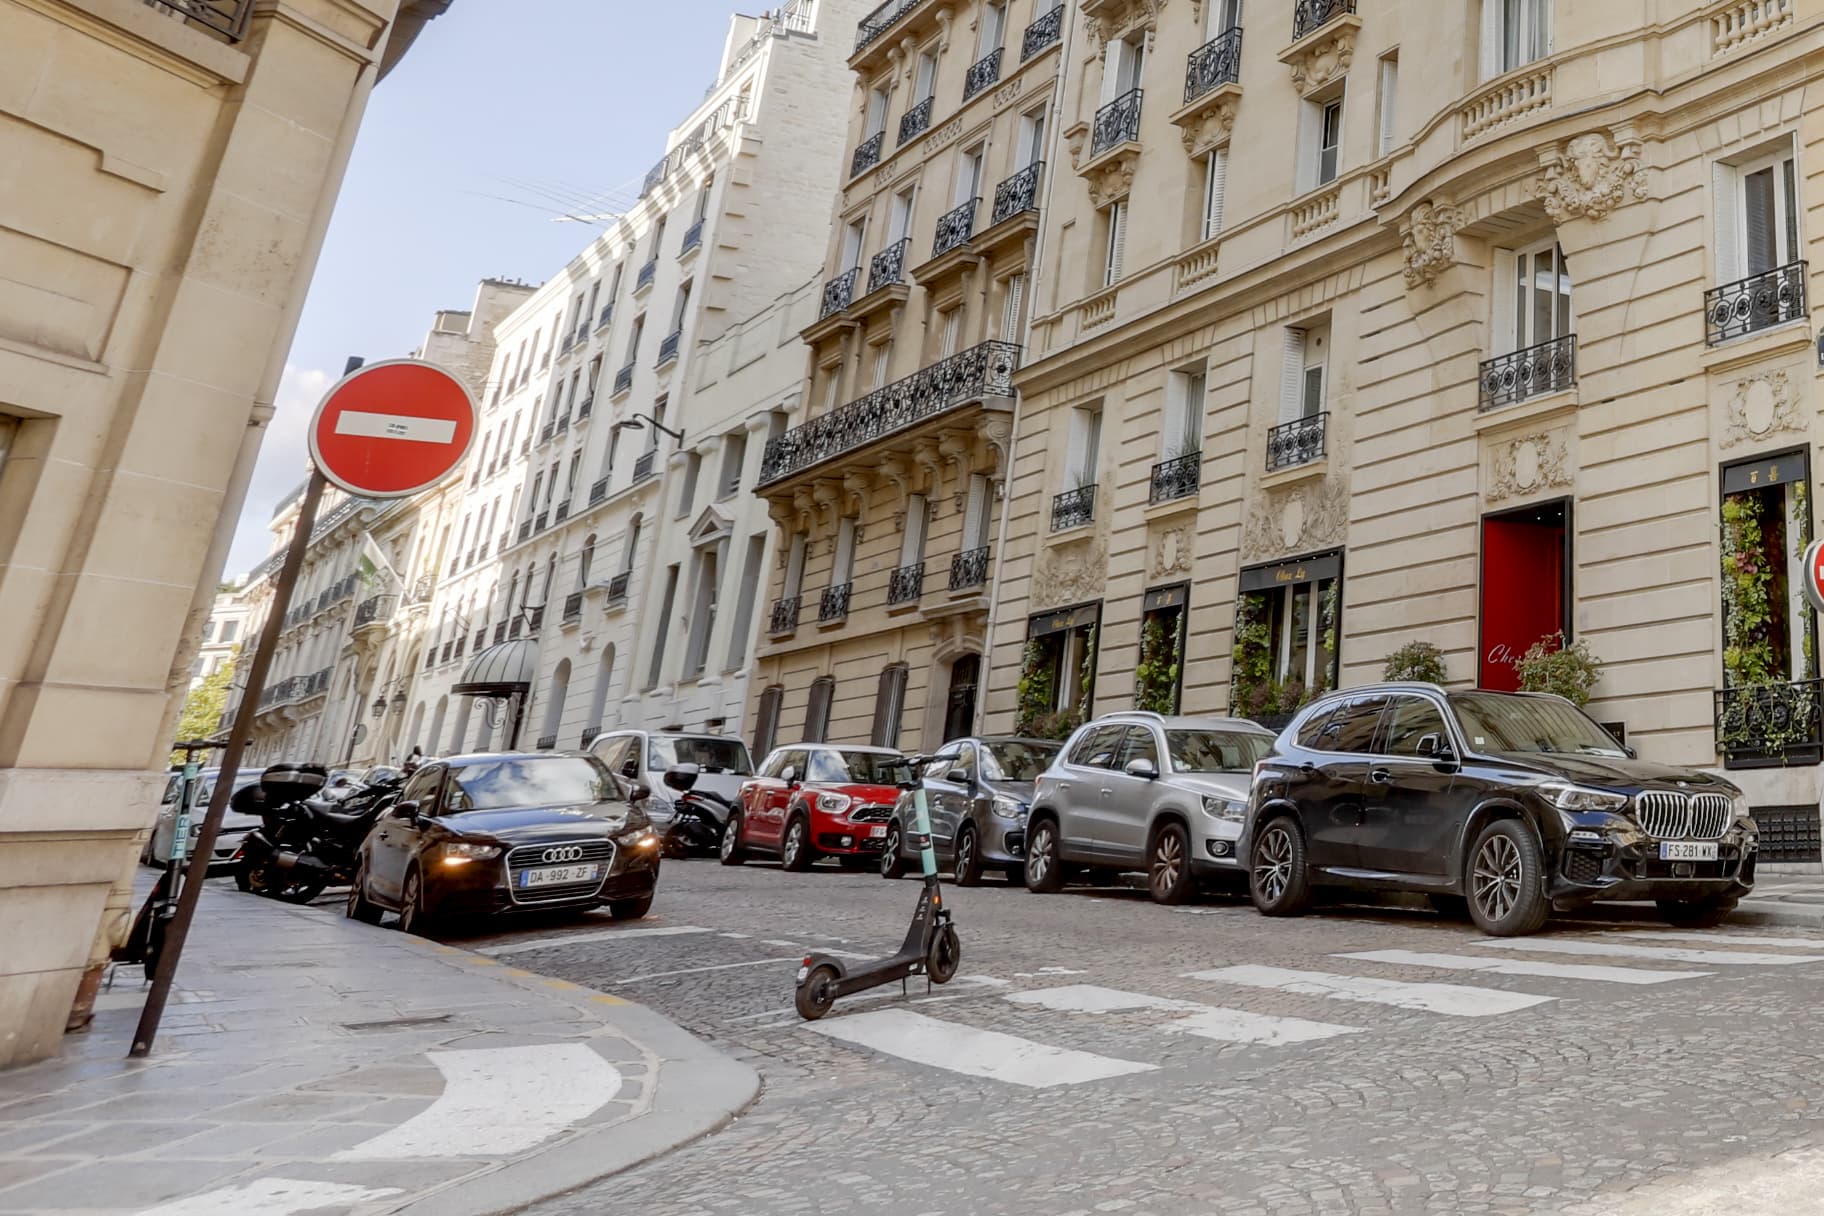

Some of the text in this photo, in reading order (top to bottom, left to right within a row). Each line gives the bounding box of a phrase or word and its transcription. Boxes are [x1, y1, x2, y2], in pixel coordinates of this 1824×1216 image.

[1487, 643, 1523, 665] Che
[173, 816, 189, 857] TIER
[530, 867, 589, 884] DA-992-ZF
